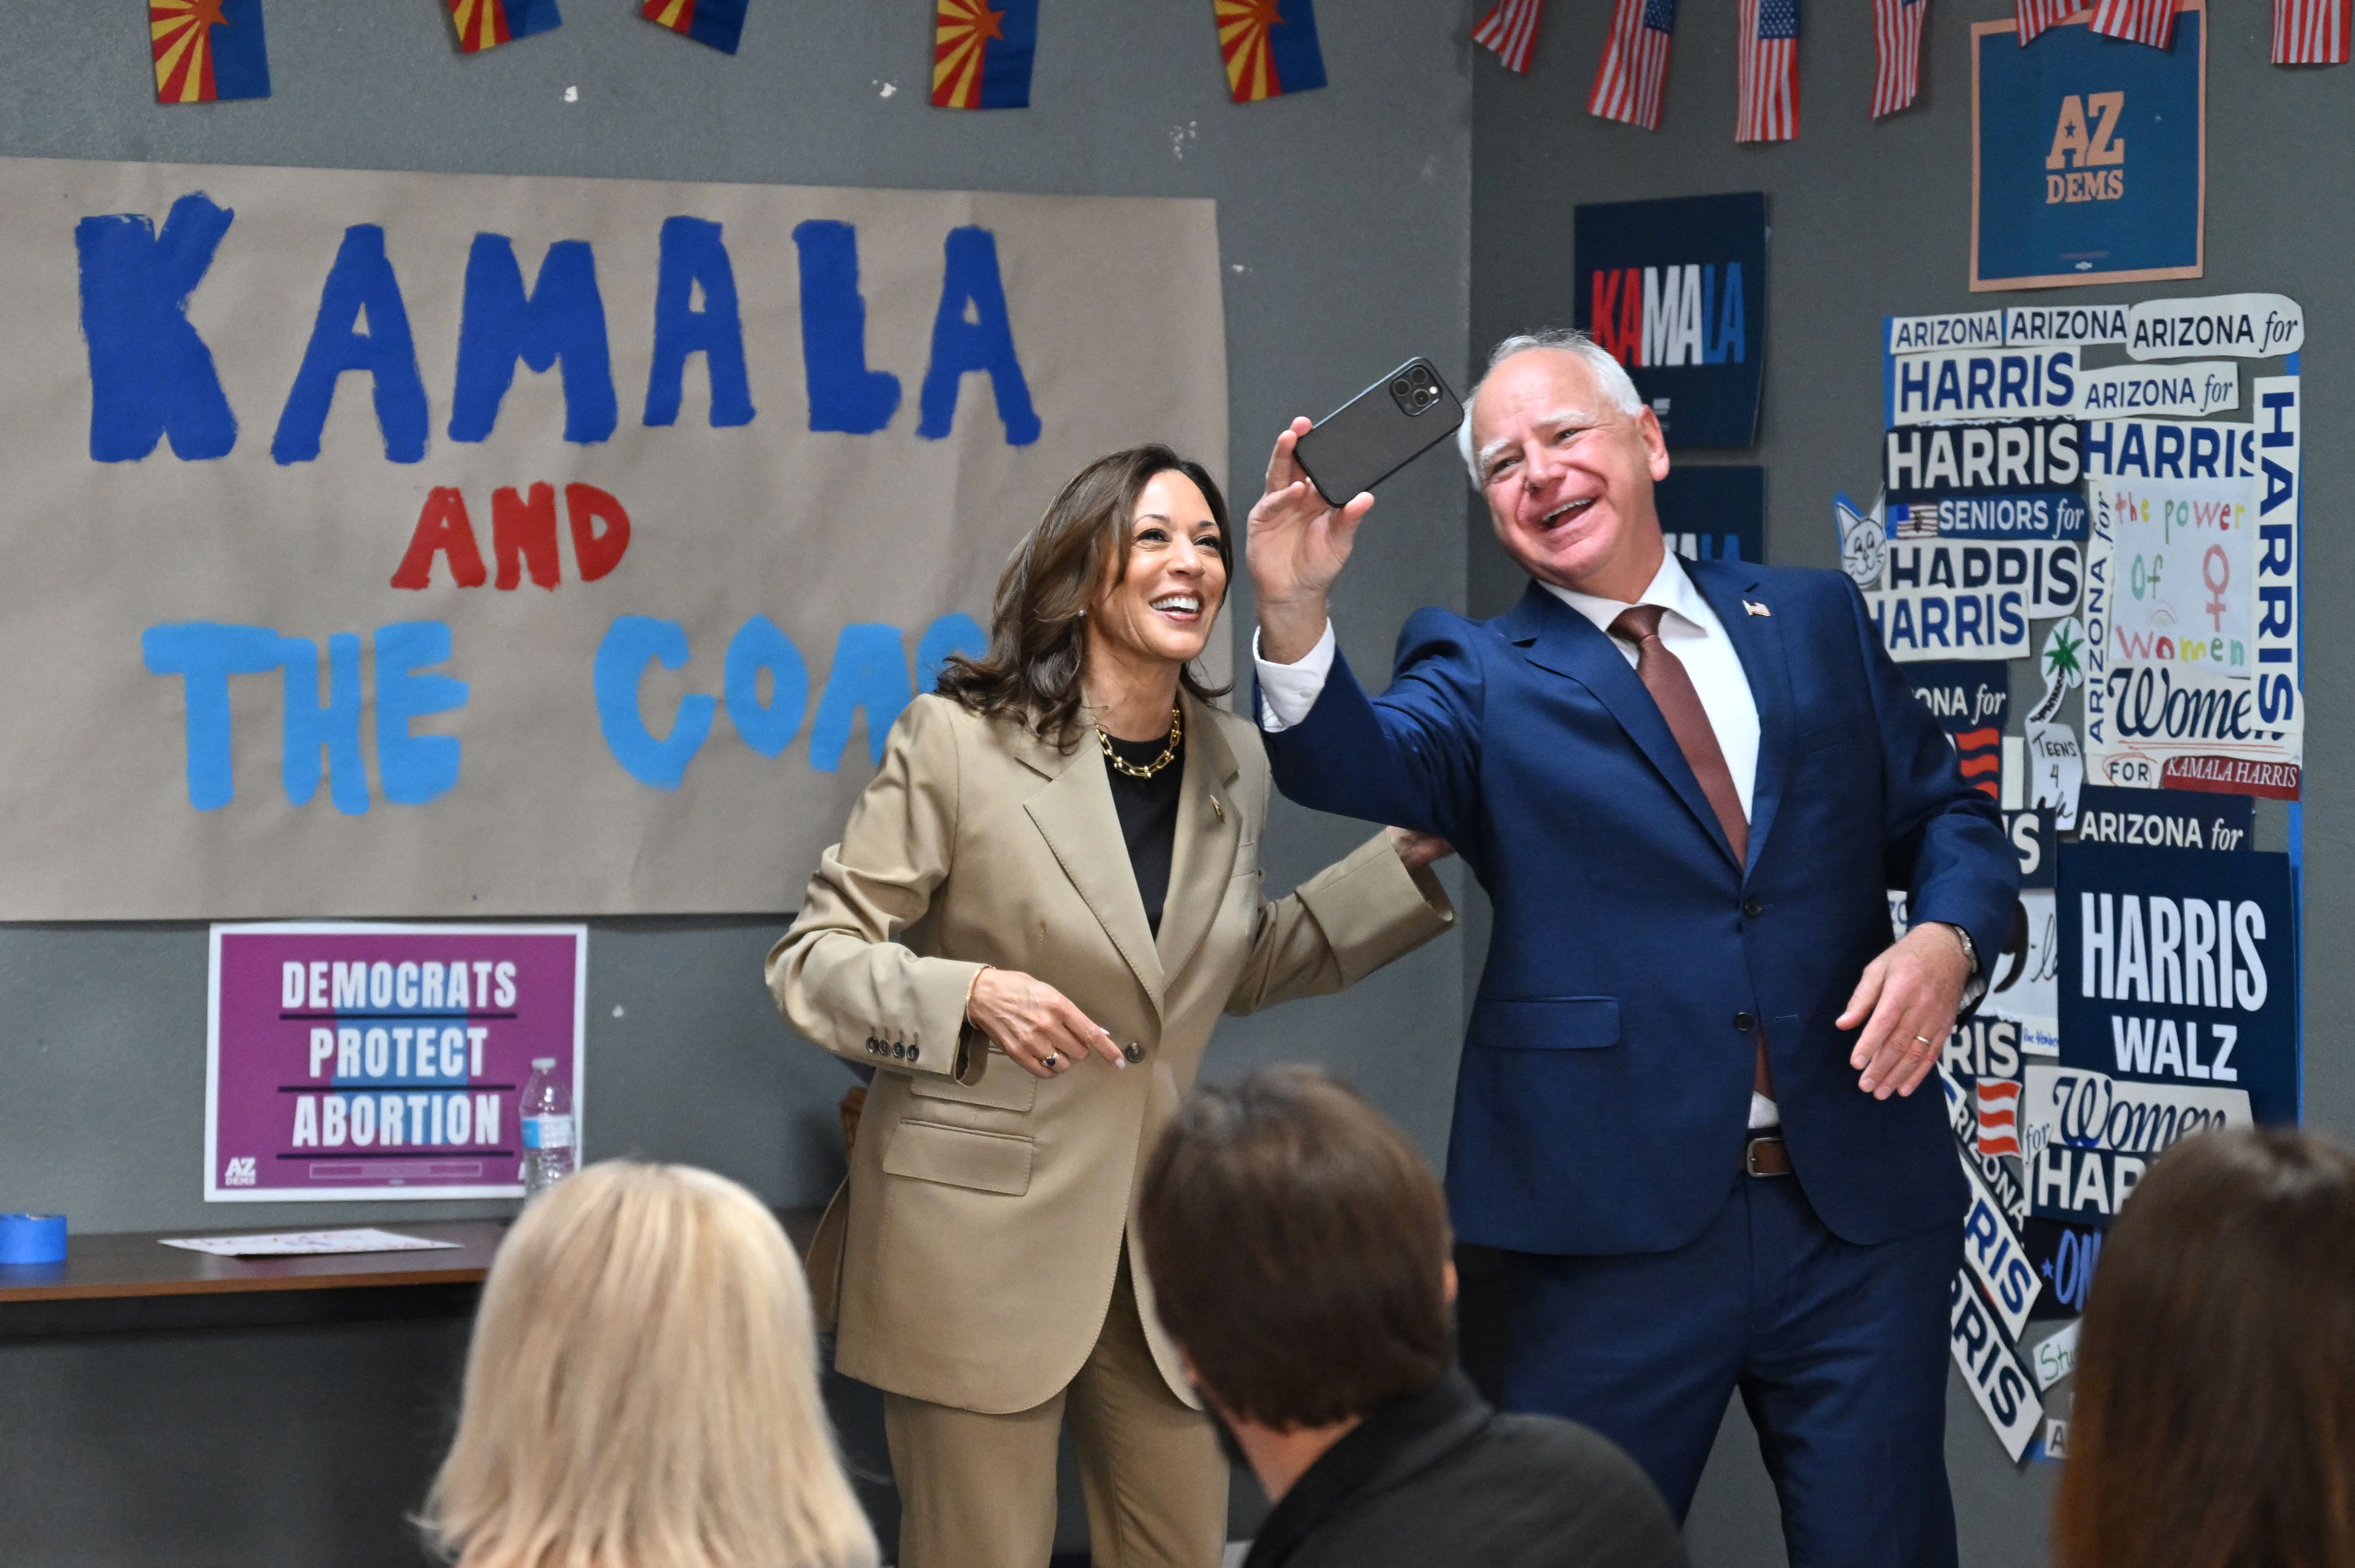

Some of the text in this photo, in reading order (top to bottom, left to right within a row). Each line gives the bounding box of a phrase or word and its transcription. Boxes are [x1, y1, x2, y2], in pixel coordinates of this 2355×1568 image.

[2046, 91, 2125, 169] AZ
[2046, 169, 2124, 204] DEMS
[75, 191, 1042, 463] KAMALA
[1592, 262, 1745, 368] KAMALA
[1897, 316, 1999, 347] ARIZONA
[2010, 309, 2128, 339] ARIZONA
[2133, 312, 2298, 353] ARIZONA for
[1900, 352, 2075, 413] HARRIS
[2085, 374, 2234, 412] ARIZONA for
[1888, 422, 2080, 490] HARRIS
[390, 481, 631, 591] AND
[1939, 498, 2084, 541] SENIORS for
[2114, 491, 2246, 545] the power
[2258, 391, 2295, 724] HARRIS
[2088, 491, 2114, 744] ARIZONA for
[141, 619, 469, 815] THE
[1971, 683, 2007, 726] for
[2107, 667, 2285, 740] Wome
[2050, 764, 2059, 788] 4
[2110, 757, 2297, 788] FOR KAMALA HARRIS
[2080, 811, 2204, 849] ARIZONA
[2211, 817, 2244, 852] for
[2082, 891, 2268, 1012] HARRIS
[281, 961, 517, 1010] DEMOCRATS
[309, 1027, 488, 1078] PROTECT
[2111, 1015, 2238, 1082] WALZ
[291, 1094, 500, 1147] ABORTION
[2024, 1123, 2051, 1165] for
[225, 1157, 256, 1176] AZ
